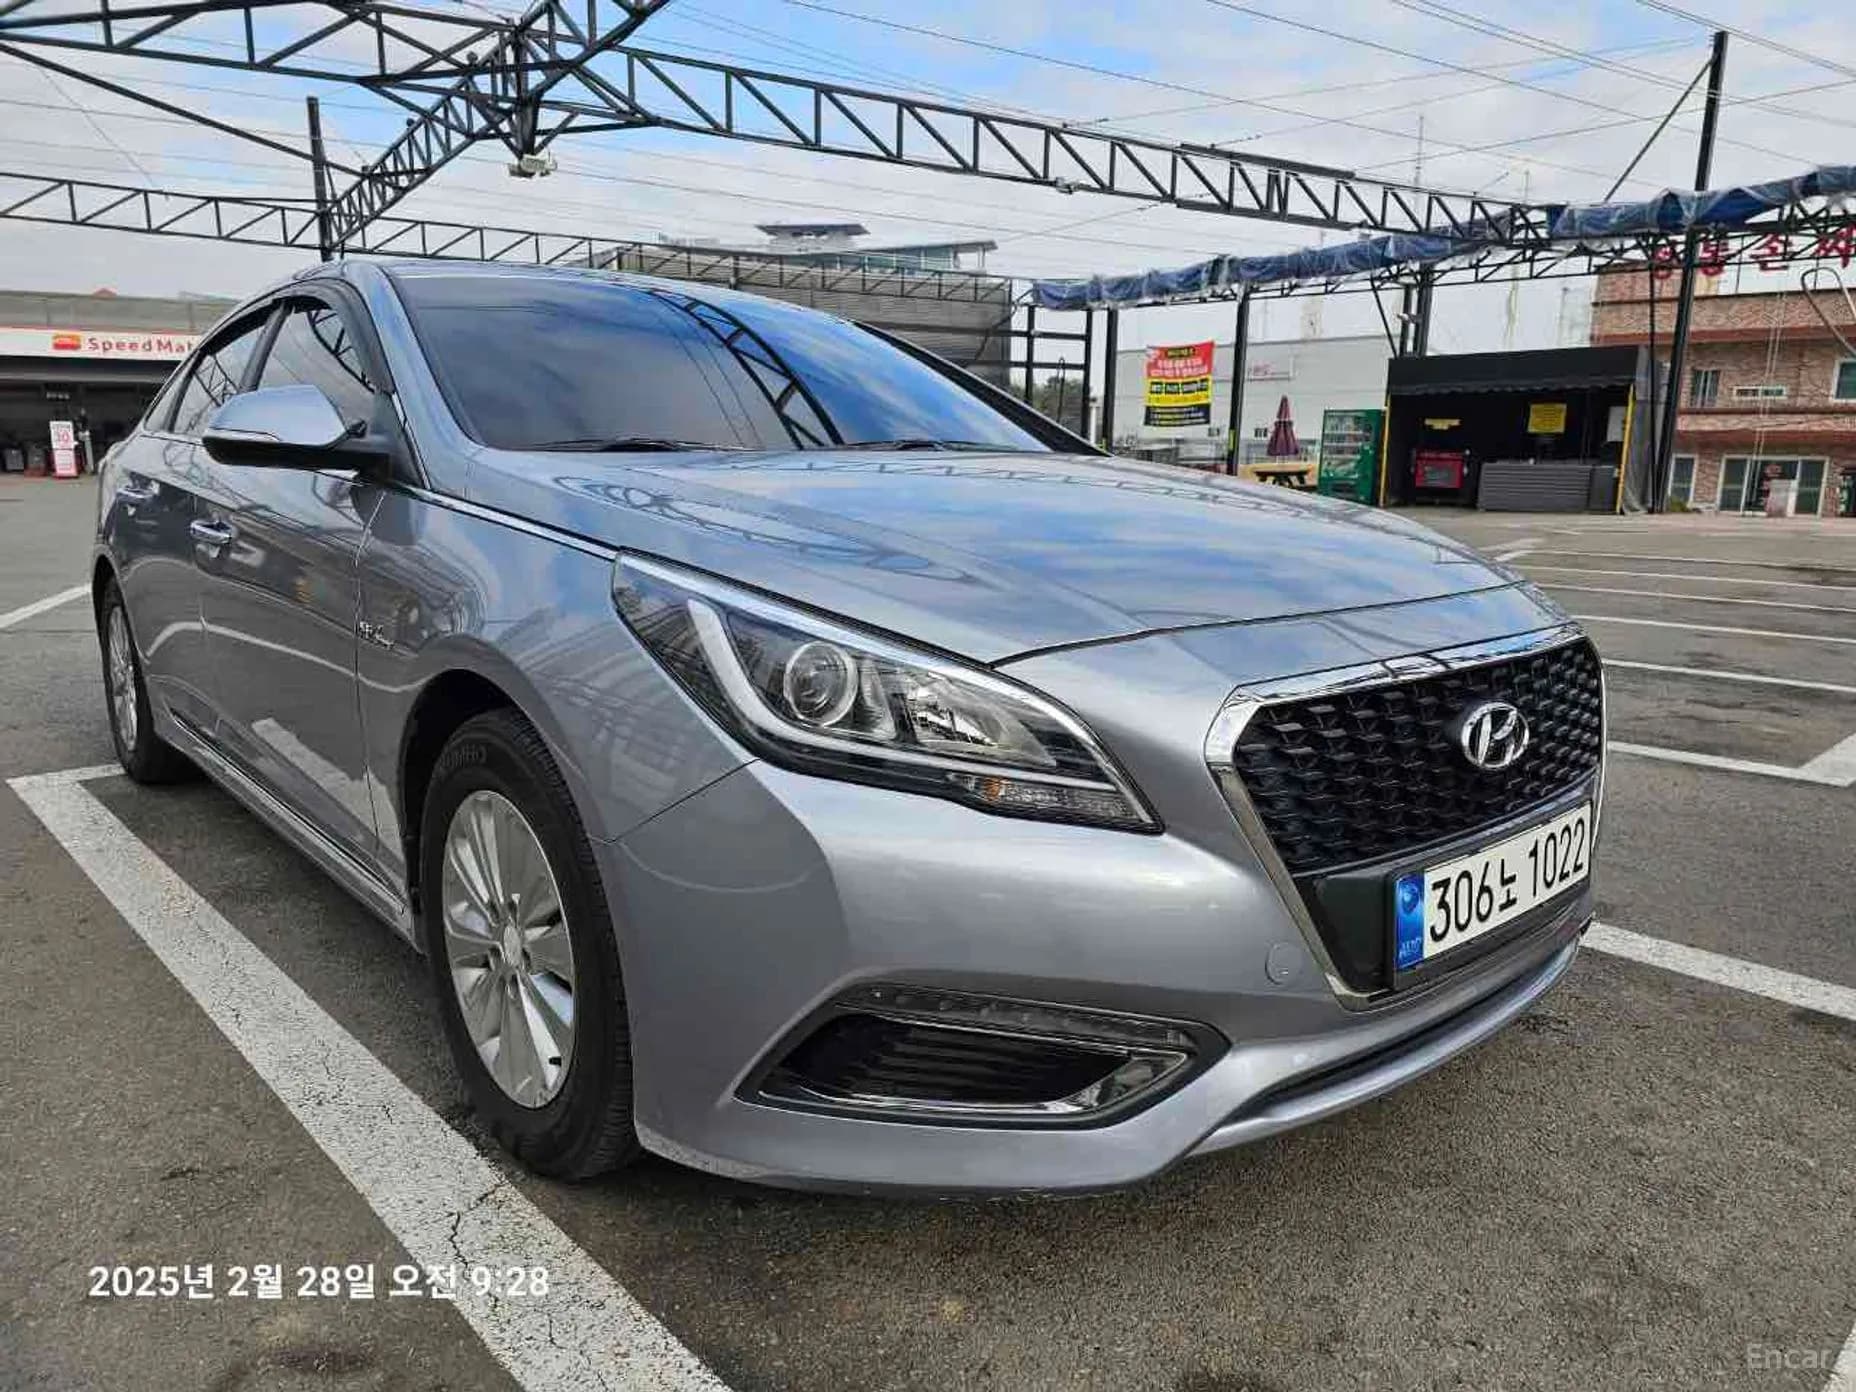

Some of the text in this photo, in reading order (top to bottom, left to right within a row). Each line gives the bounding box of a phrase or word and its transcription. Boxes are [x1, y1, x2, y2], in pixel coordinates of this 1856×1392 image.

[88, 337, 195, 354] SpeedMat
[1430, 817, 1585, 942] 306노 1022
